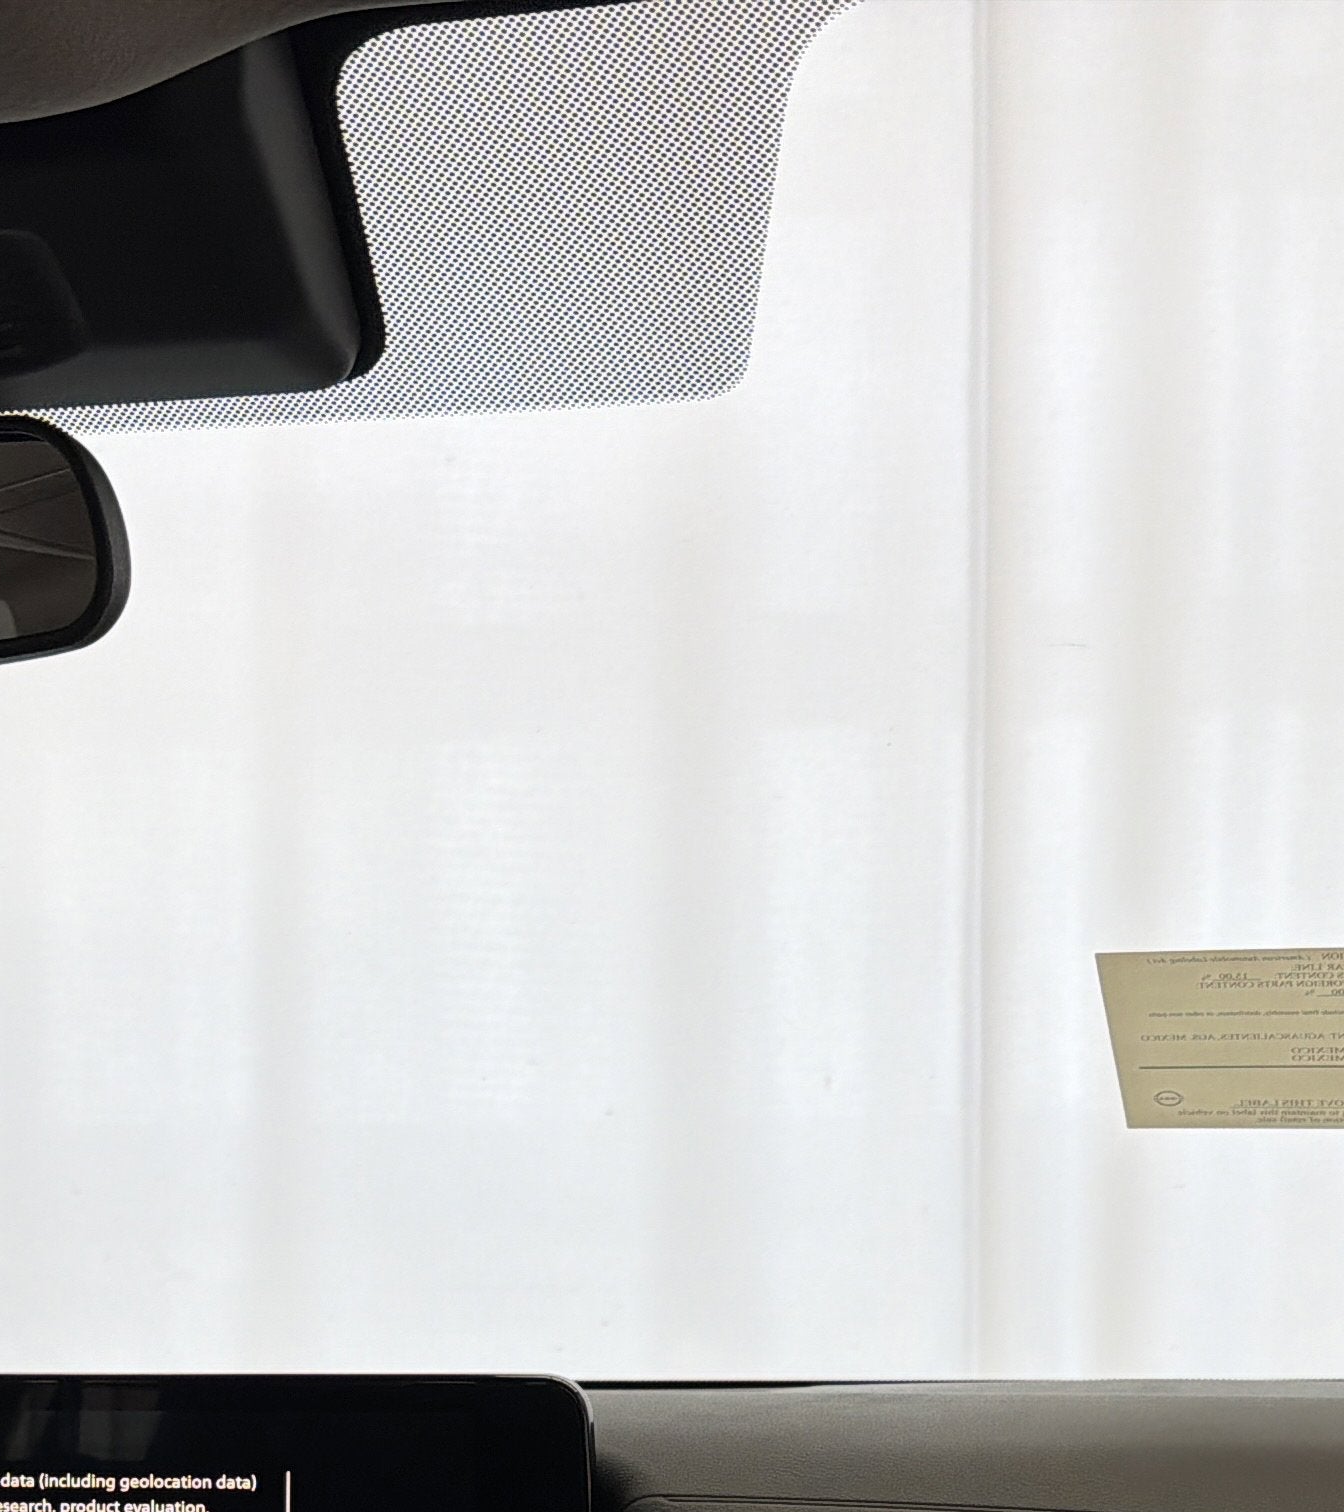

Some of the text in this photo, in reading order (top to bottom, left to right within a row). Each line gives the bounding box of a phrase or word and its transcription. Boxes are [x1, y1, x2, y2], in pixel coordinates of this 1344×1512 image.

[38, 1471, 116, 1493] (including
[118, 1472, 213, 1493] geolocation
[214, 1473, 257, 1493] data)
